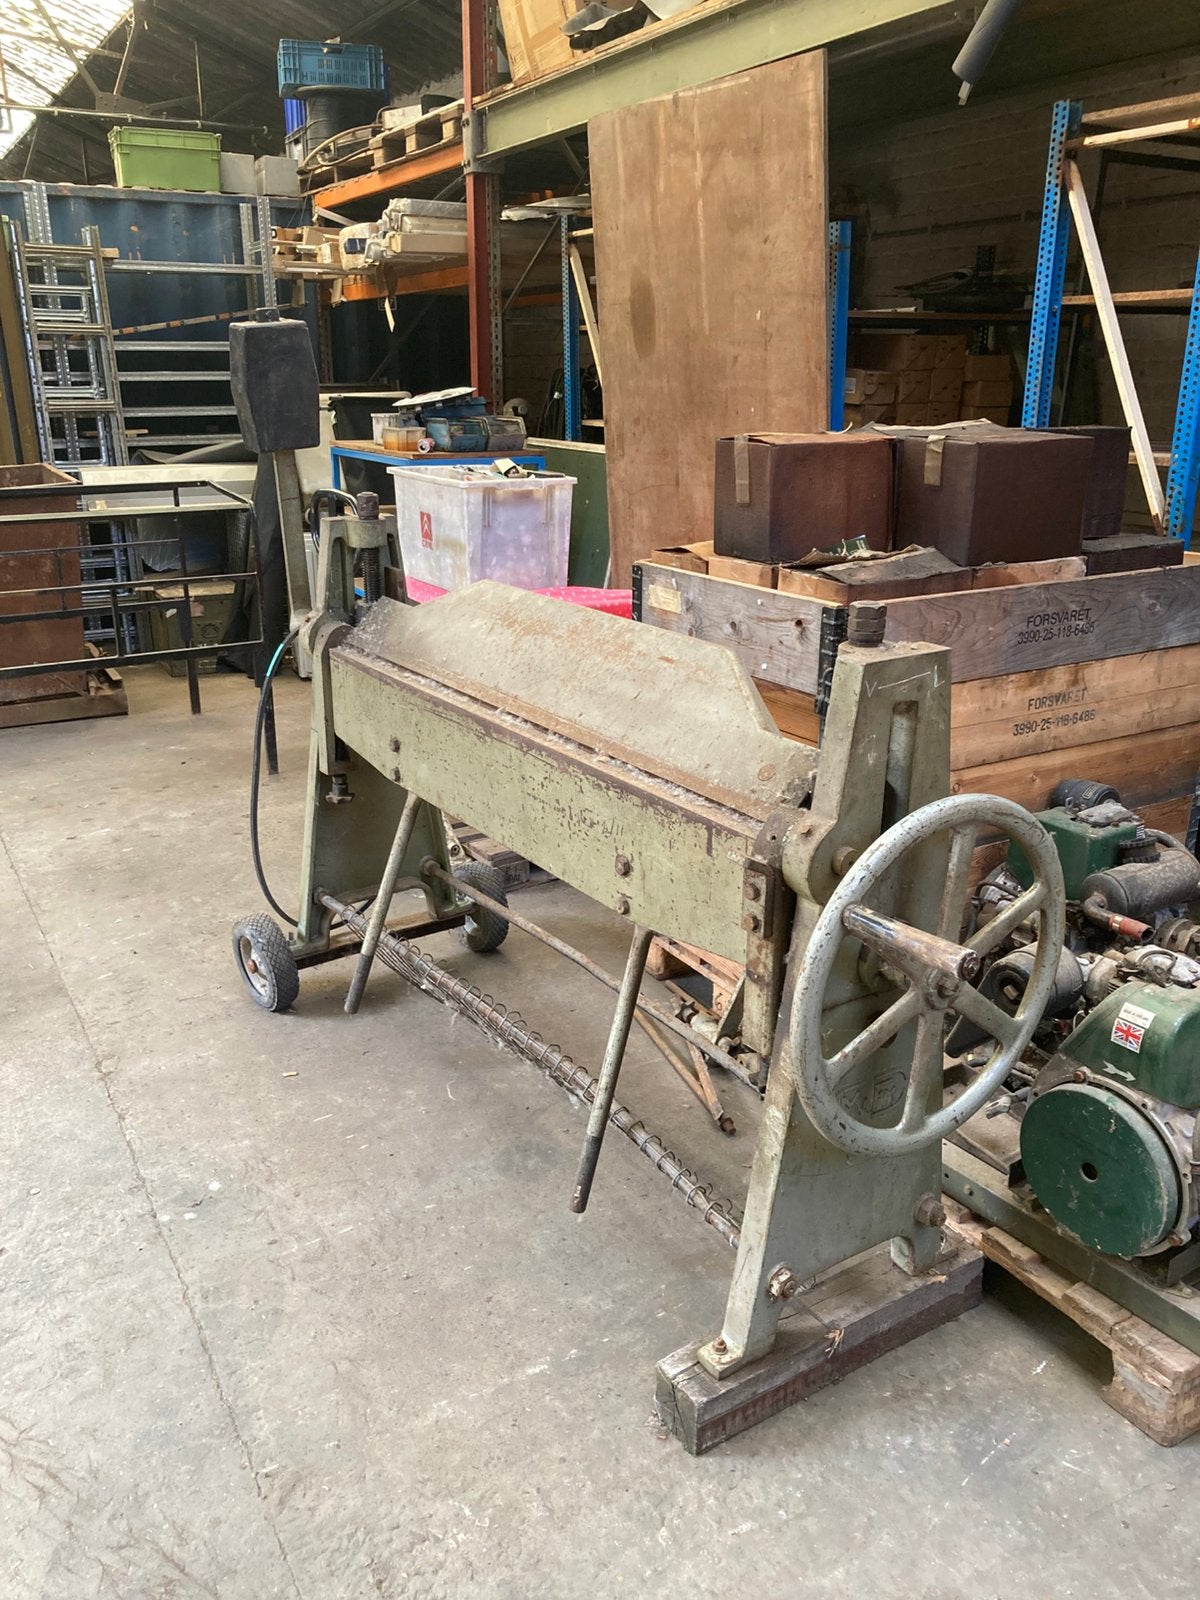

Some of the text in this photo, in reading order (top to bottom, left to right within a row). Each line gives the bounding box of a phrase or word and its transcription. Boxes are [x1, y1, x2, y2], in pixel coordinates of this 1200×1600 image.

[1026, 608, 1092, 629] FORSVARET
[1027, 688, 1088, 712] FORSVARET
[1012, 709, 1096, 737] 3990-25-118-6486
